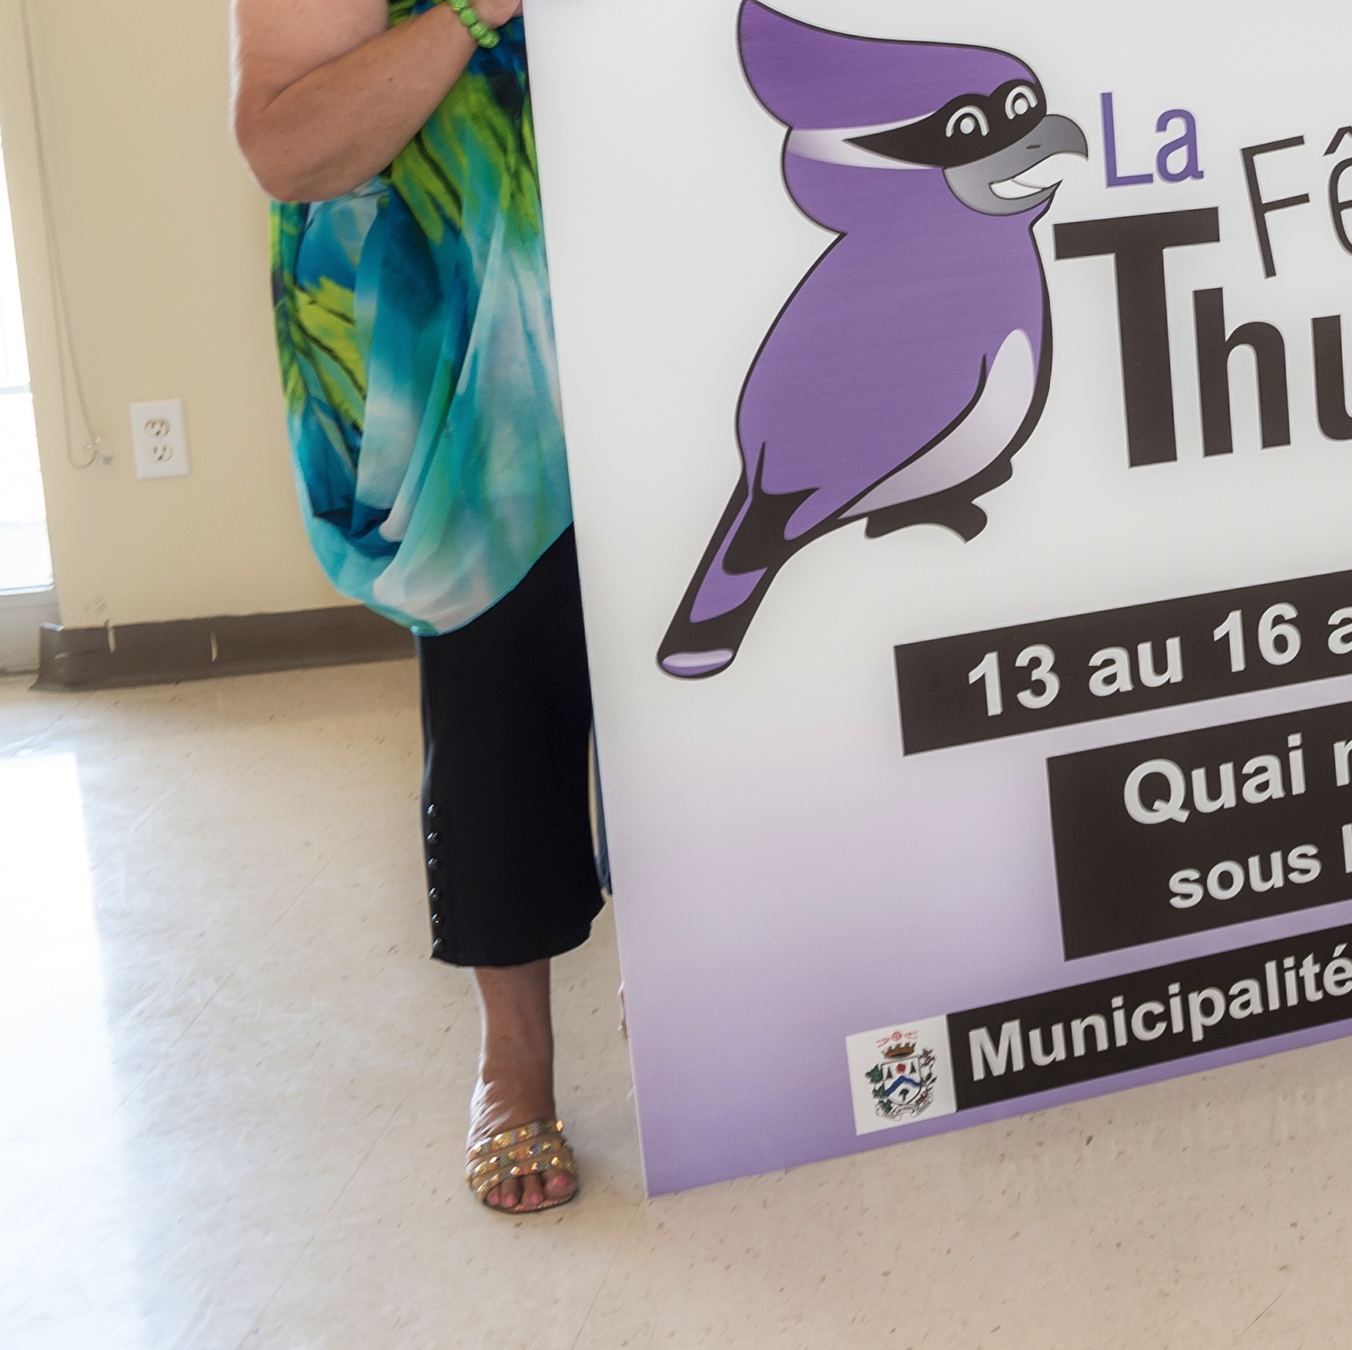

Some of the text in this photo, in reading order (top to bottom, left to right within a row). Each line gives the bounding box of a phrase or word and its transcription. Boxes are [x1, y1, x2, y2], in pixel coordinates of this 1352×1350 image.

[1099, 90, 1206, 189] La
[967, 643, 1061, 718] 13
[1087, 635, 1185, 698] au
[1212, 601, 1303, 674] 16
[1122, 731, 1307, 826] Quai
[1167, 843, 1323, 910] sous
